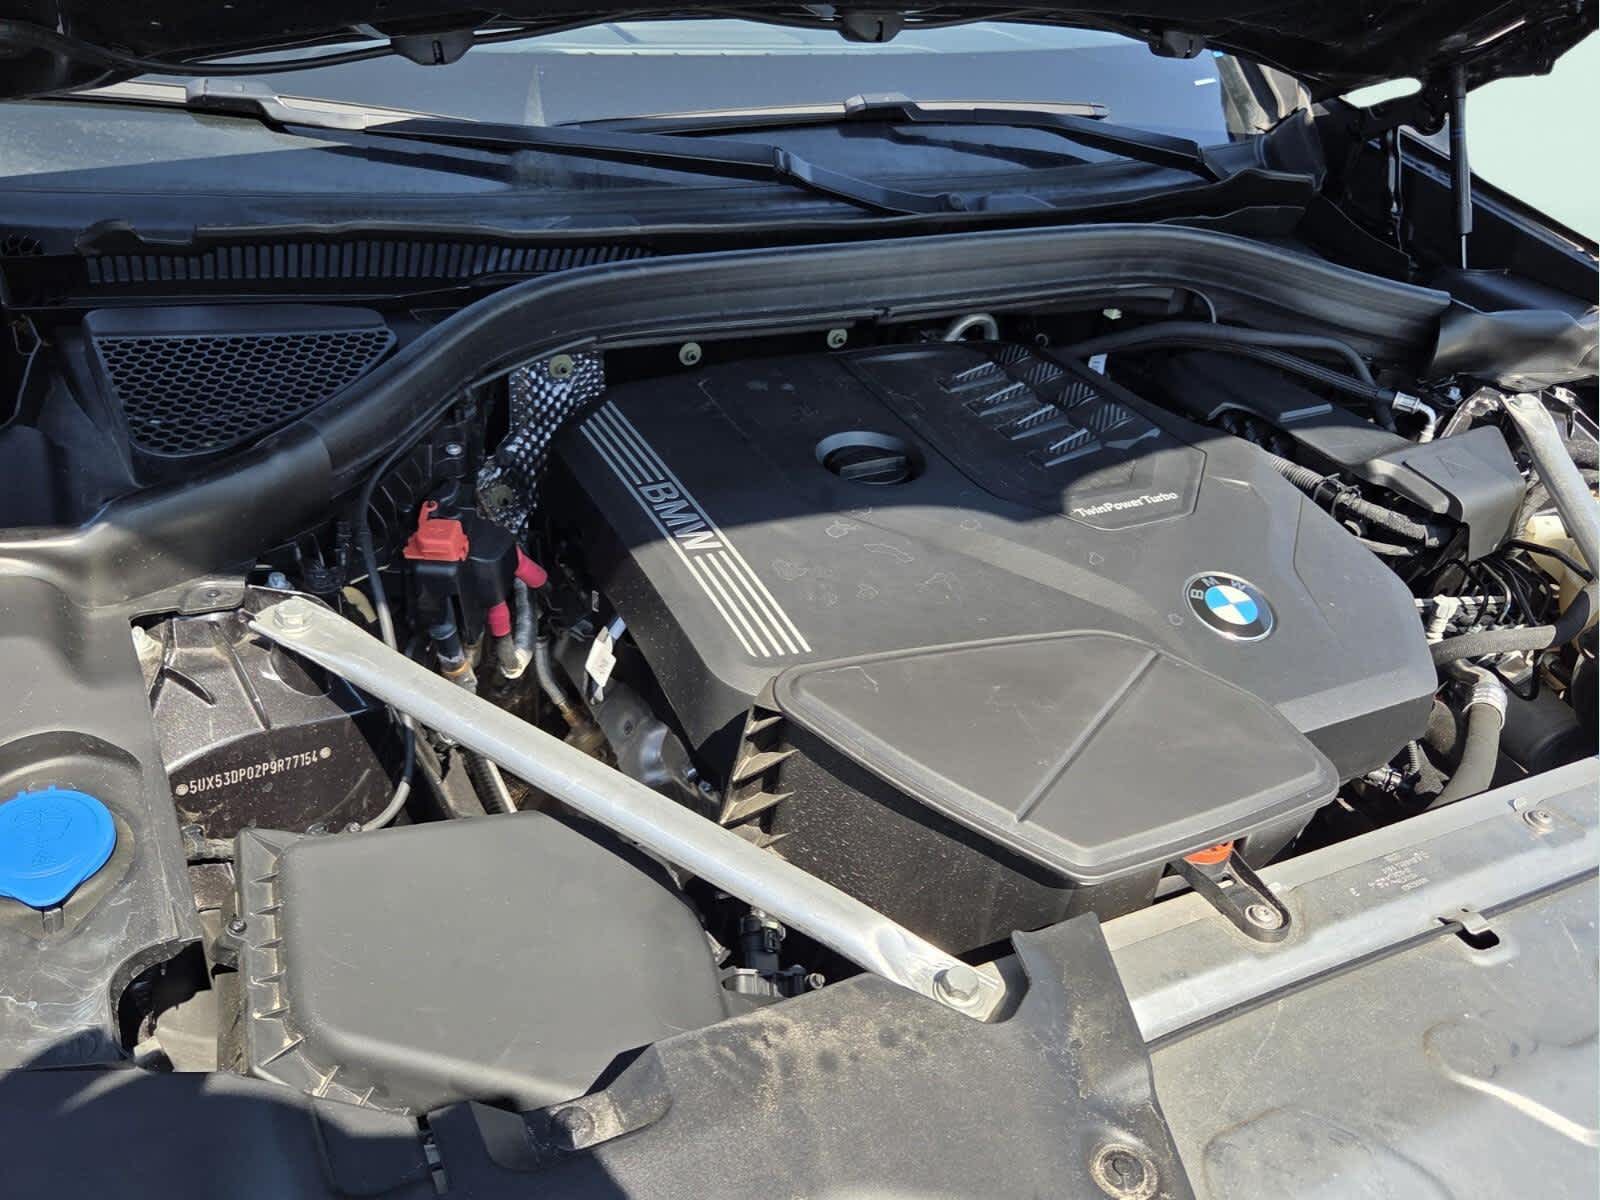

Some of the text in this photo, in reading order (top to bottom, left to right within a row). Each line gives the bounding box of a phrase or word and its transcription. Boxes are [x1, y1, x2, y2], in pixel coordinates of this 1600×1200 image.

[639, 481, 723, 550] BMW
[1190, 576, 1246, 600] BMW
[189, 750, 318, 794] 5UX53DP02P9R77154
